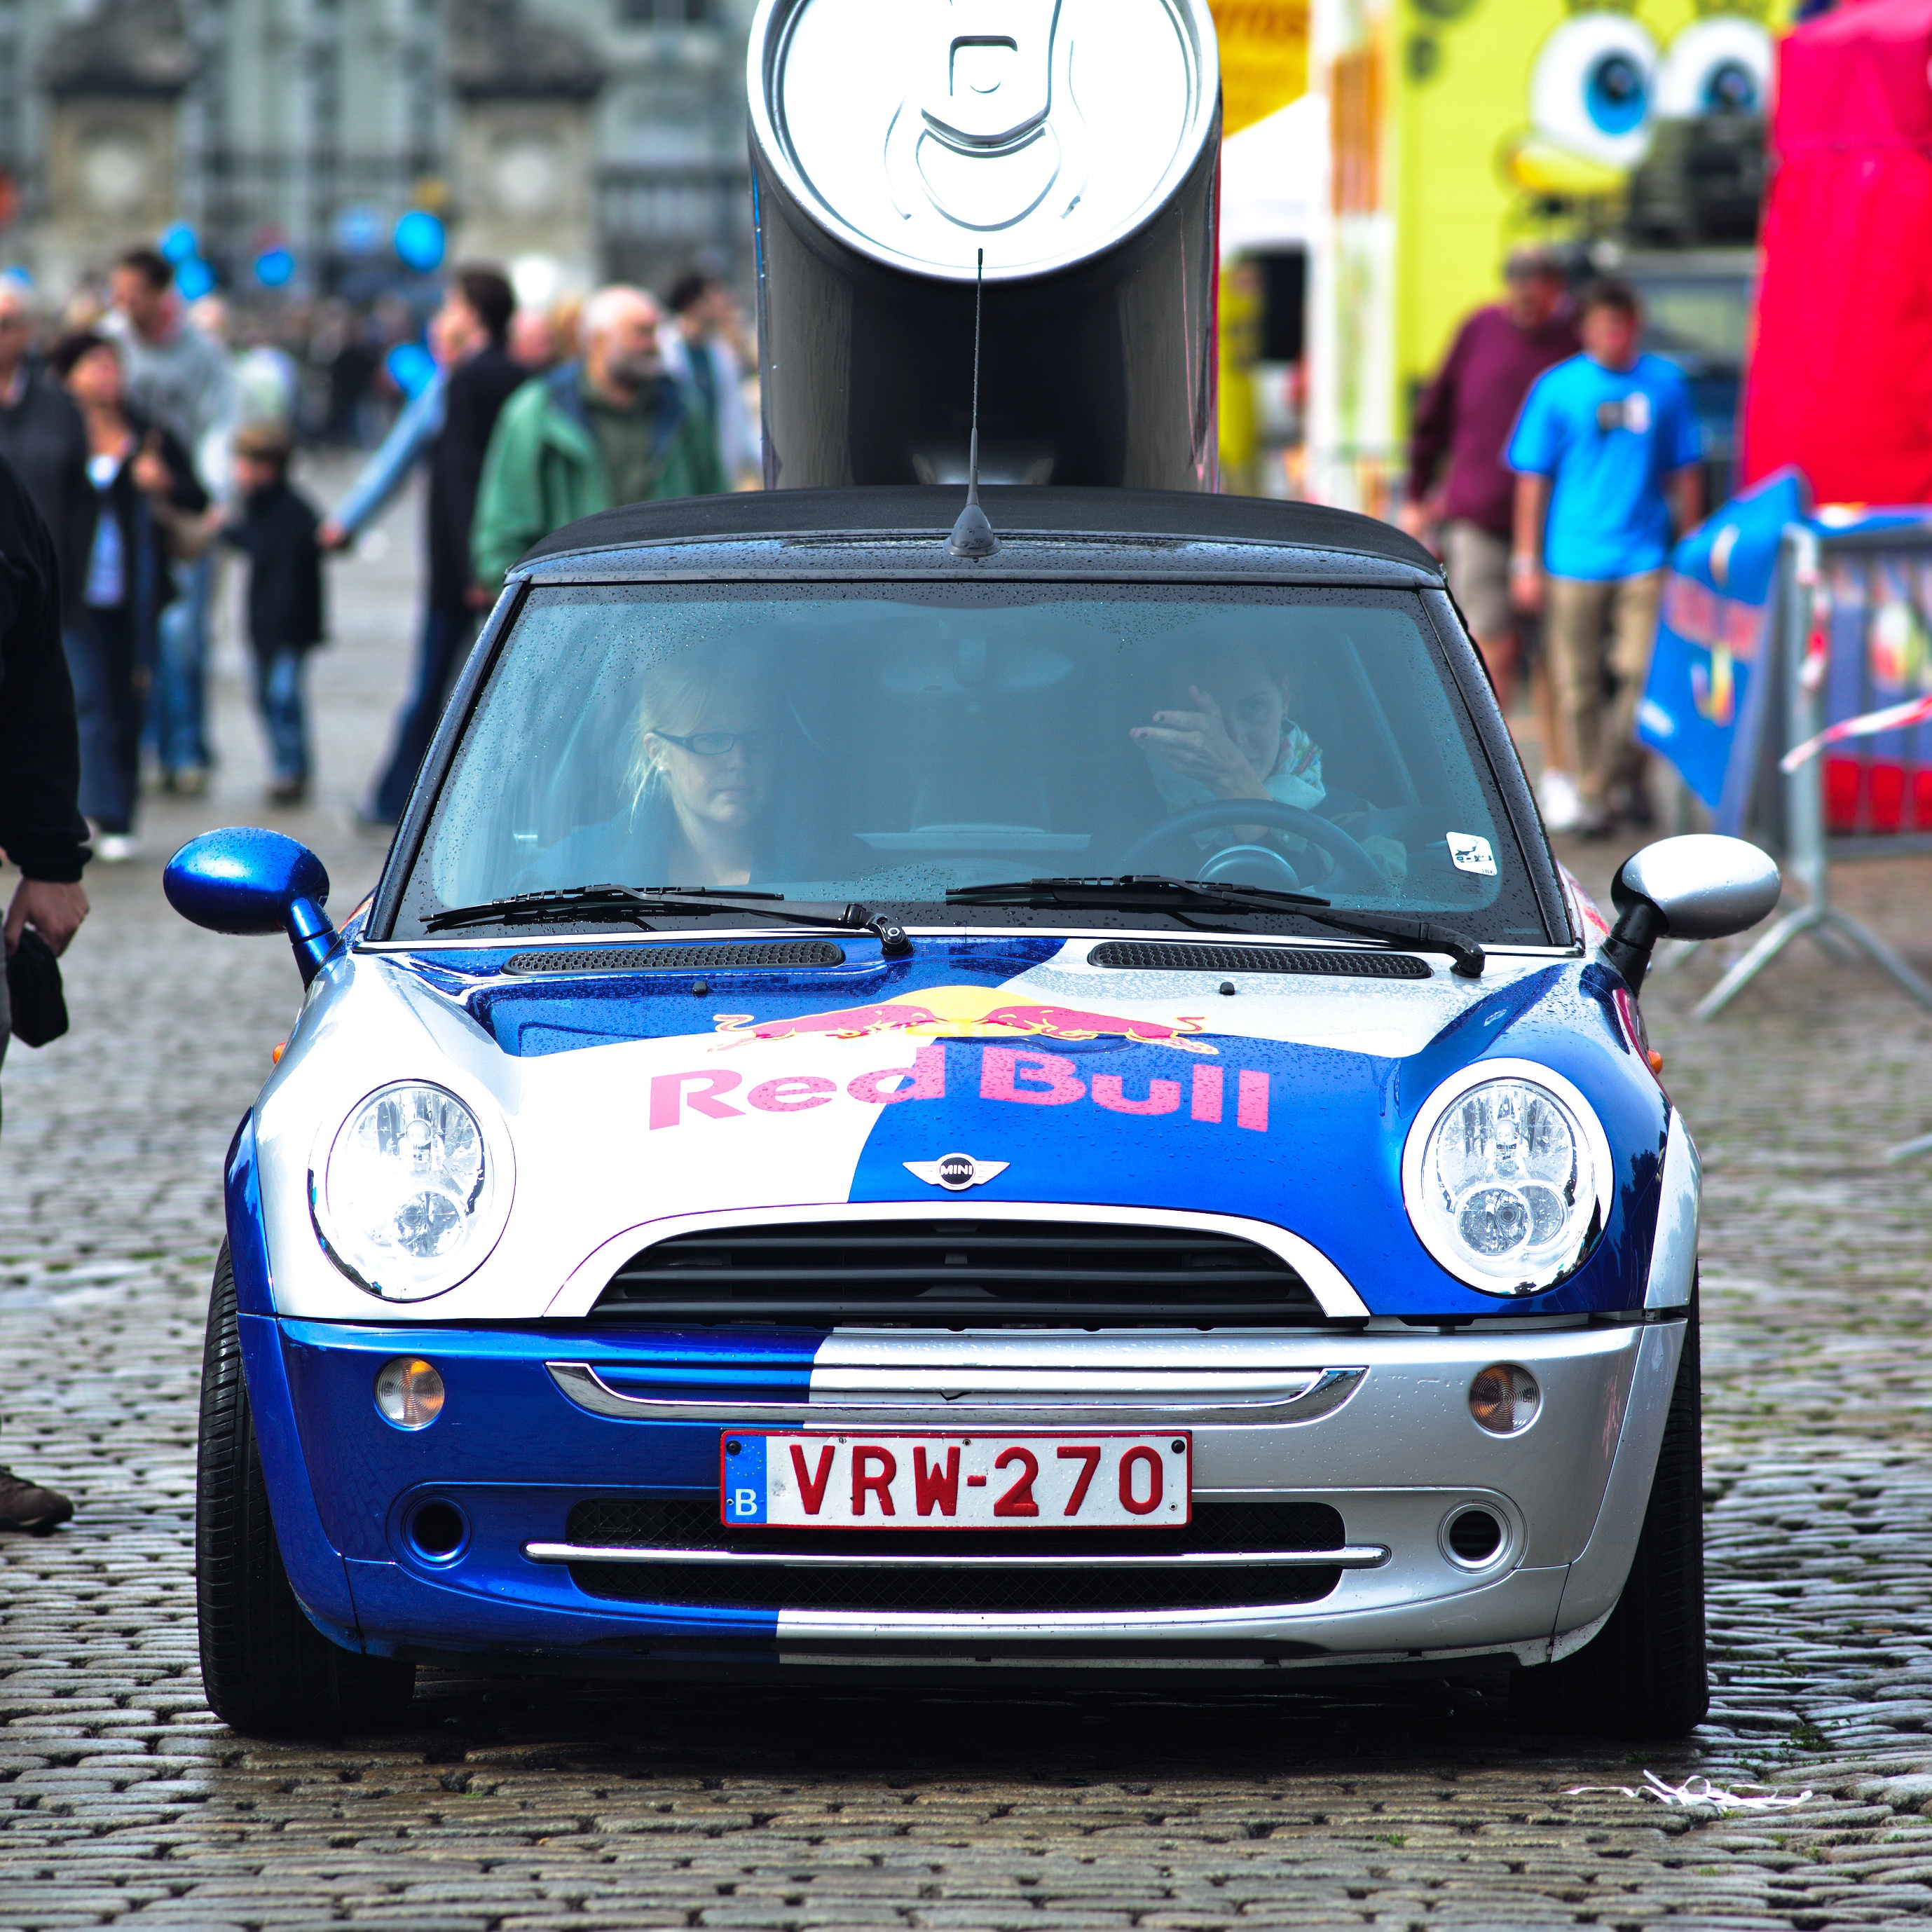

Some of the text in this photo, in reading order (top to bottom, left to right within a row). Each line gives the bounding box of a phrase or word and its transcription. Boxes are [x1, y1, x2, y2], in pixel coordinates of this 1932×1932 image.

[649, 1045, 1269, 1132] Red Bull
[940, 1164, 973, 1176] MINI
[735, 1488, 758, 1516] B
[789, 1444, 1163, 1517] VRW-270
